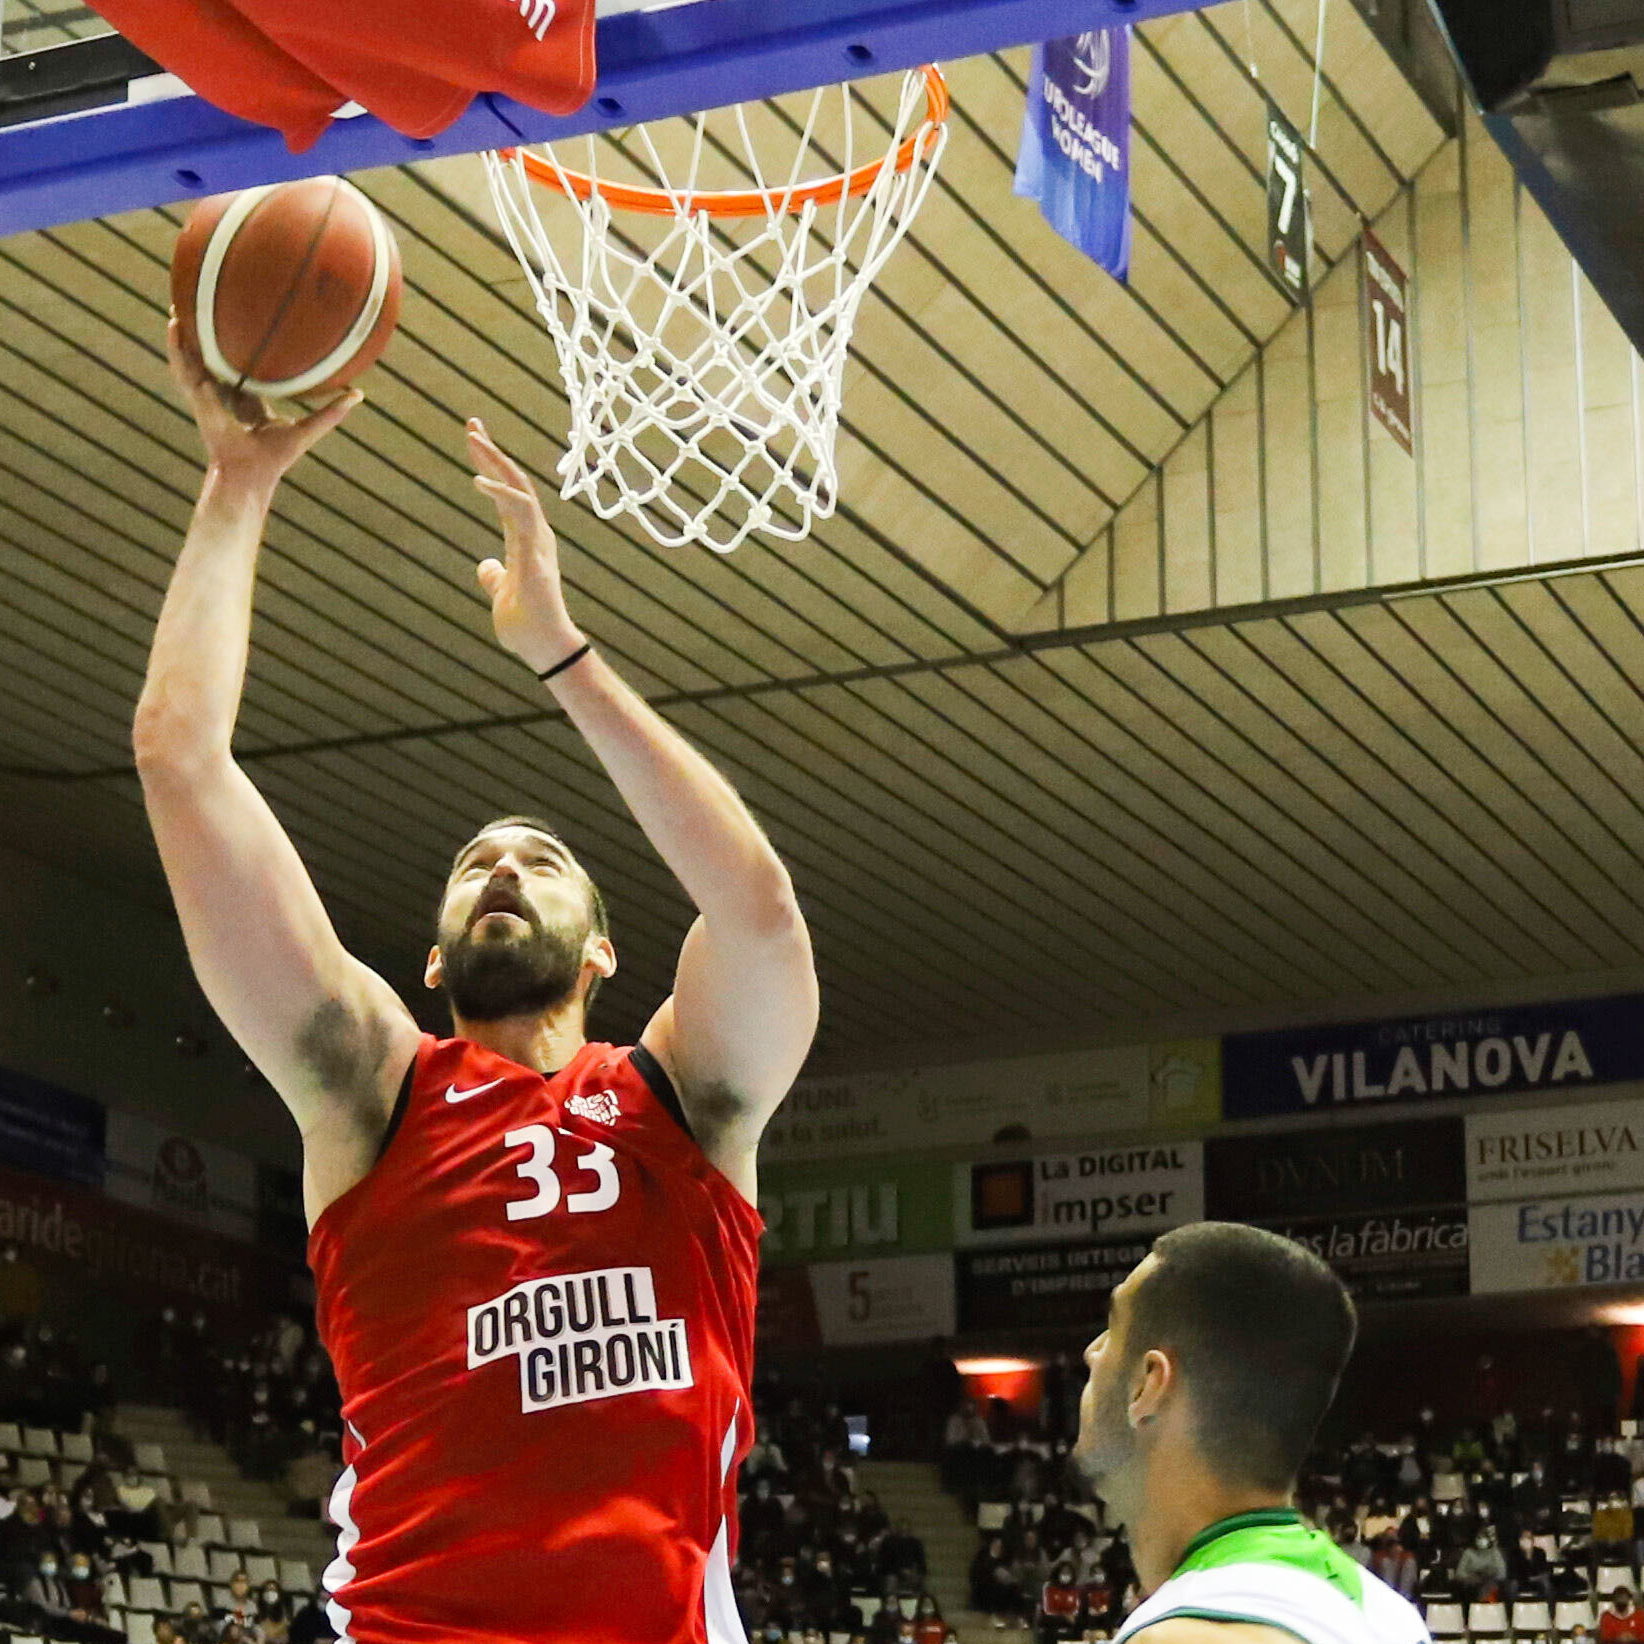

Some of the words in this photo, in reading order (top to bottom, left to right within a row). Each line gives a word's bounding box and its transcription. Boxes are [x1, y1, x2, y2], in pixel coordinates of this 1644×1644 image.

[1043, 76, 1120, 171] UROLEAGUE
[1274, 154, 1298, 235] 7
[1371, 298, 1404, 396] 14
[1291, 1030, 1593, 1104] VILANOVA
[1377, 1016, 1502, 1045] CATERING
[503, 1123, 621, 1221] 33
[1040, 1157, 1072, 1181] La
[1079, 1148, 1184, 1177] DIGITAL
[1476, 1126, 1638, 1166] FRISELVA
[1040, 1188, 1174, 1232] impser
[1066, 1244, 1148, 1268] INTEGR
[474, 1272, 652, 1357] ORGULL
[526, 1322, 682, 1403] GIRONÍ
